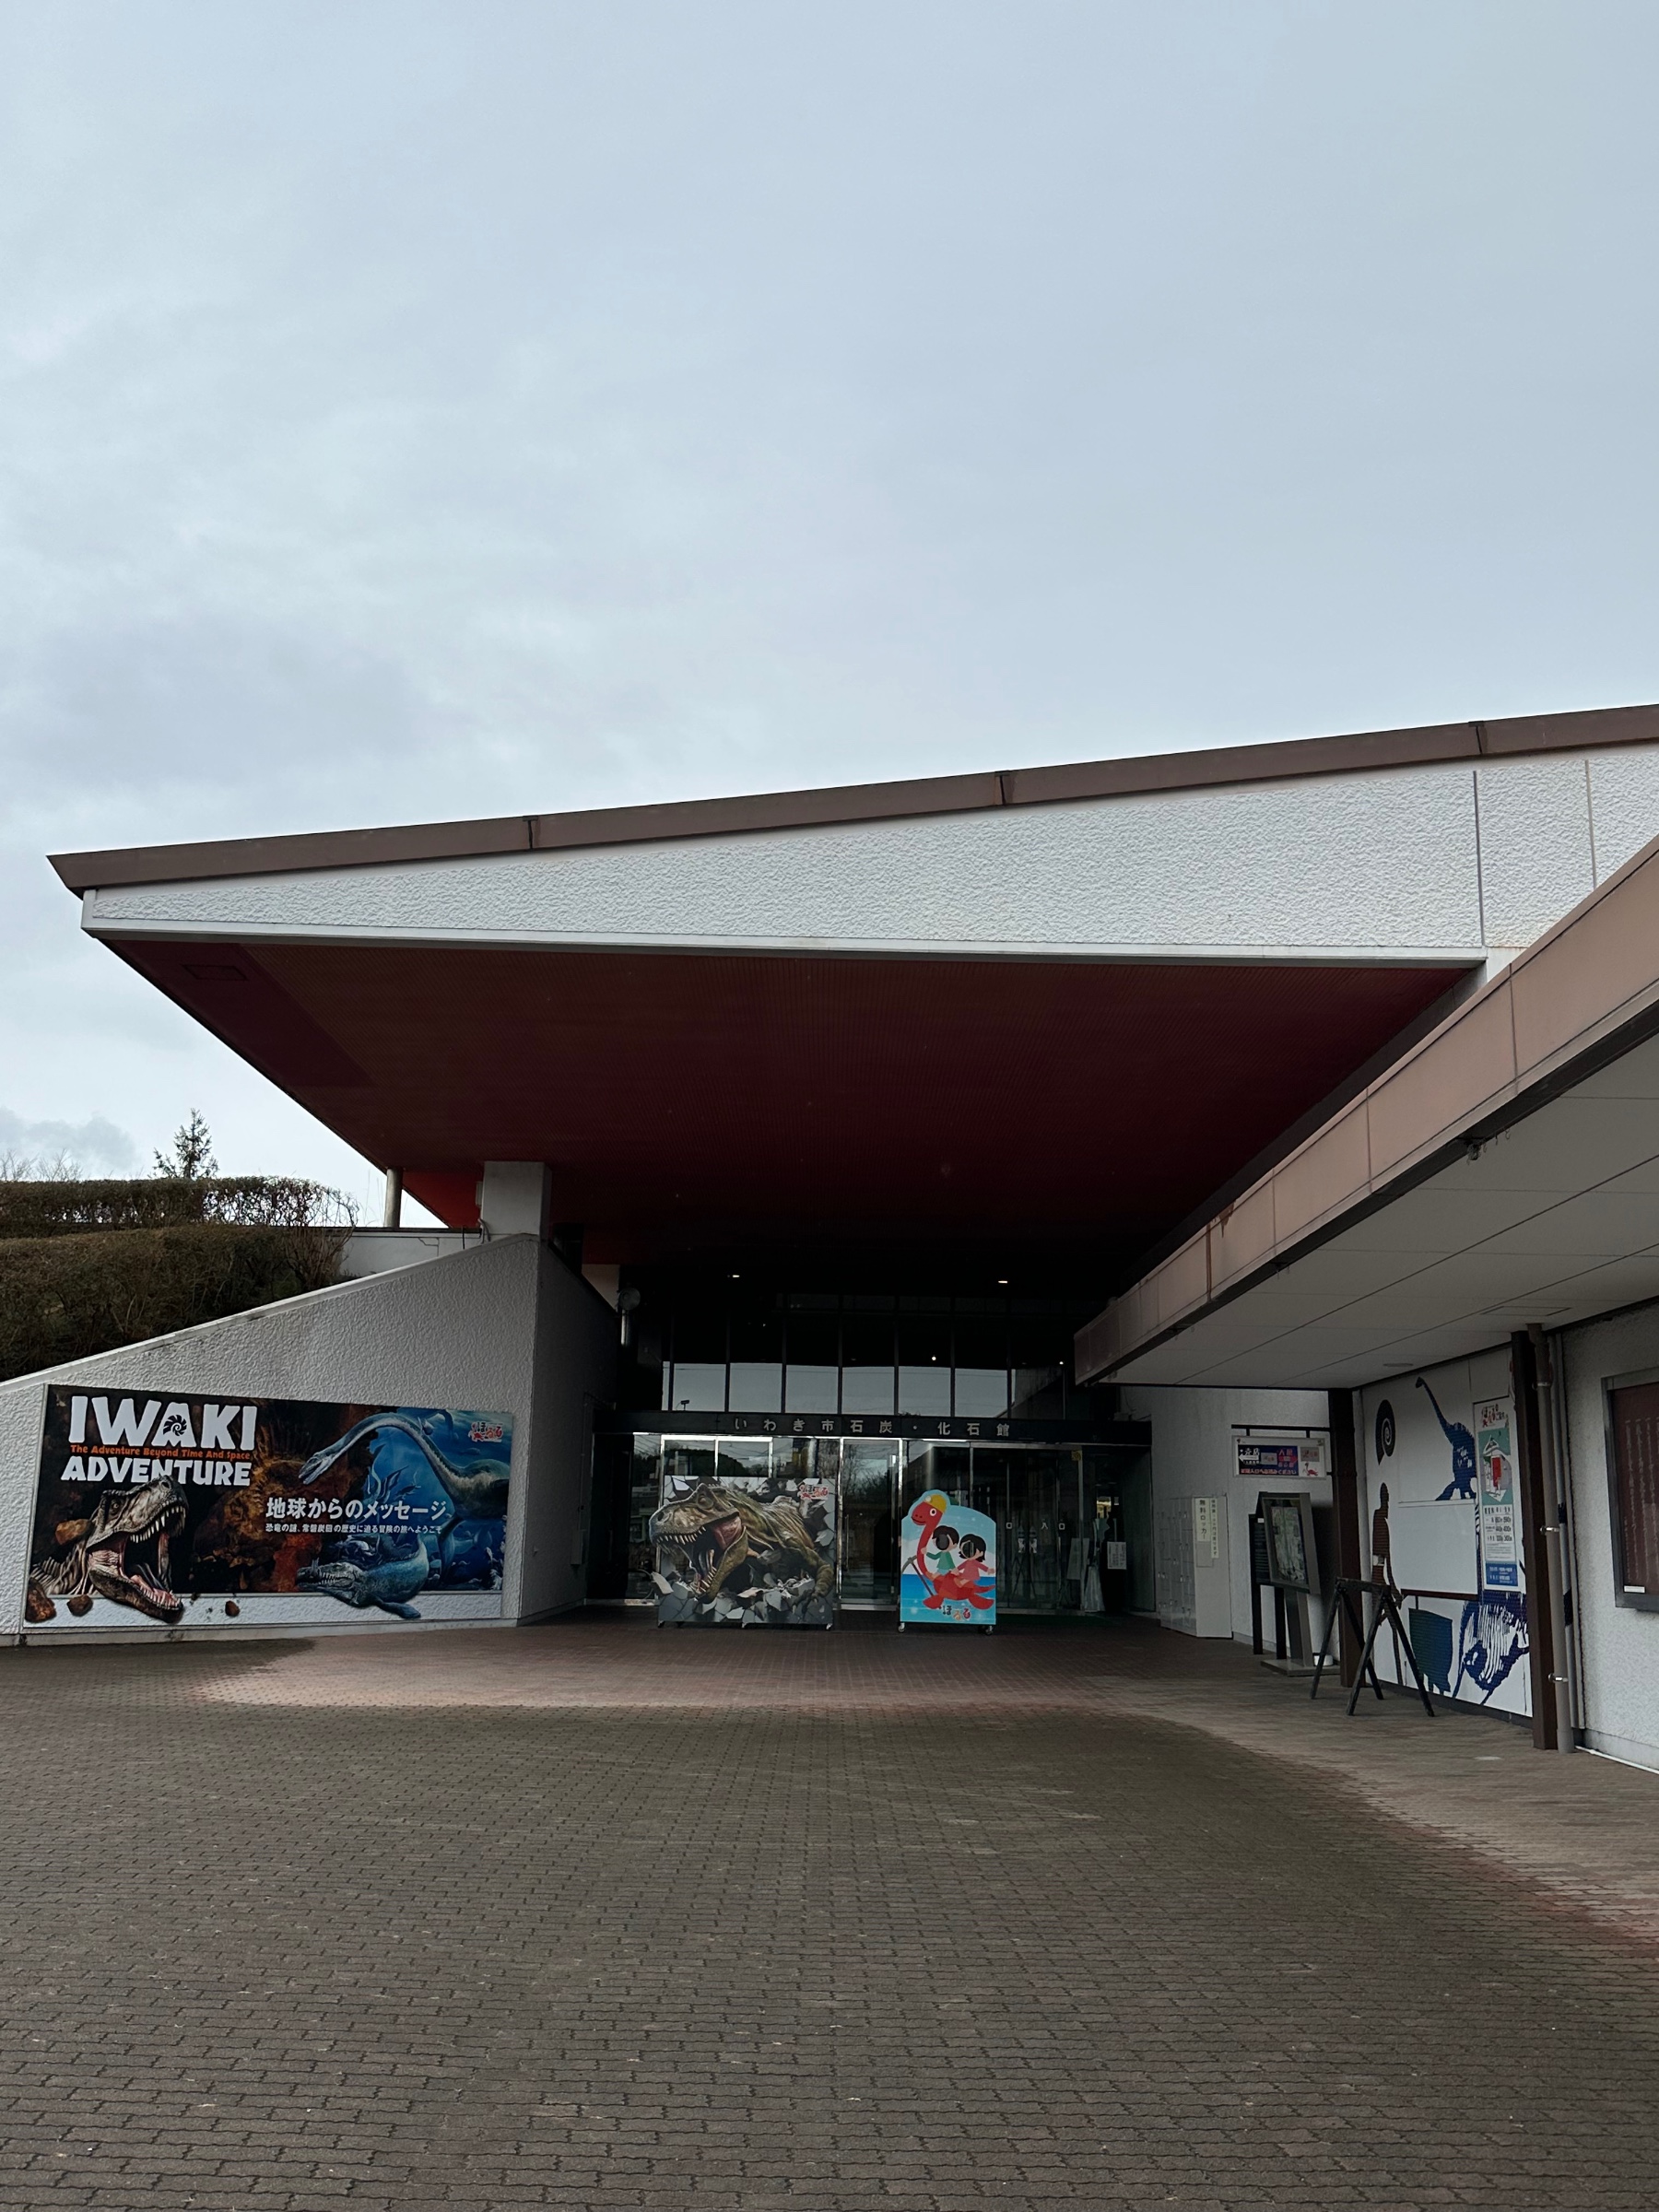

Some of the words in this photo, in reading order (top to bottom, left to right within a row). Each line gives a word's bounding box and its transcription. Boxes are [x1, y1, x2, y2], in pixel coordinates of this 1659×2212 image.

[68, 1395, 258, 1451] IWAKI
[735, 1418, 1010, 1437] いわき市石炭・化石館
[70, 1444, 88, 1453] The
[91, 1445, 141, 1455] Adventure
[143, 1447, 179, 1459] Beyond
[181, 1449, 204, 1458] Time
[206, 1450, 224, 1459] And
[227, 1451, 251, 1462] Space
[60, 1455, 253, 1487] ADVENTURE
[265, 1497, 447, 1521] 地球からのメッセージ
